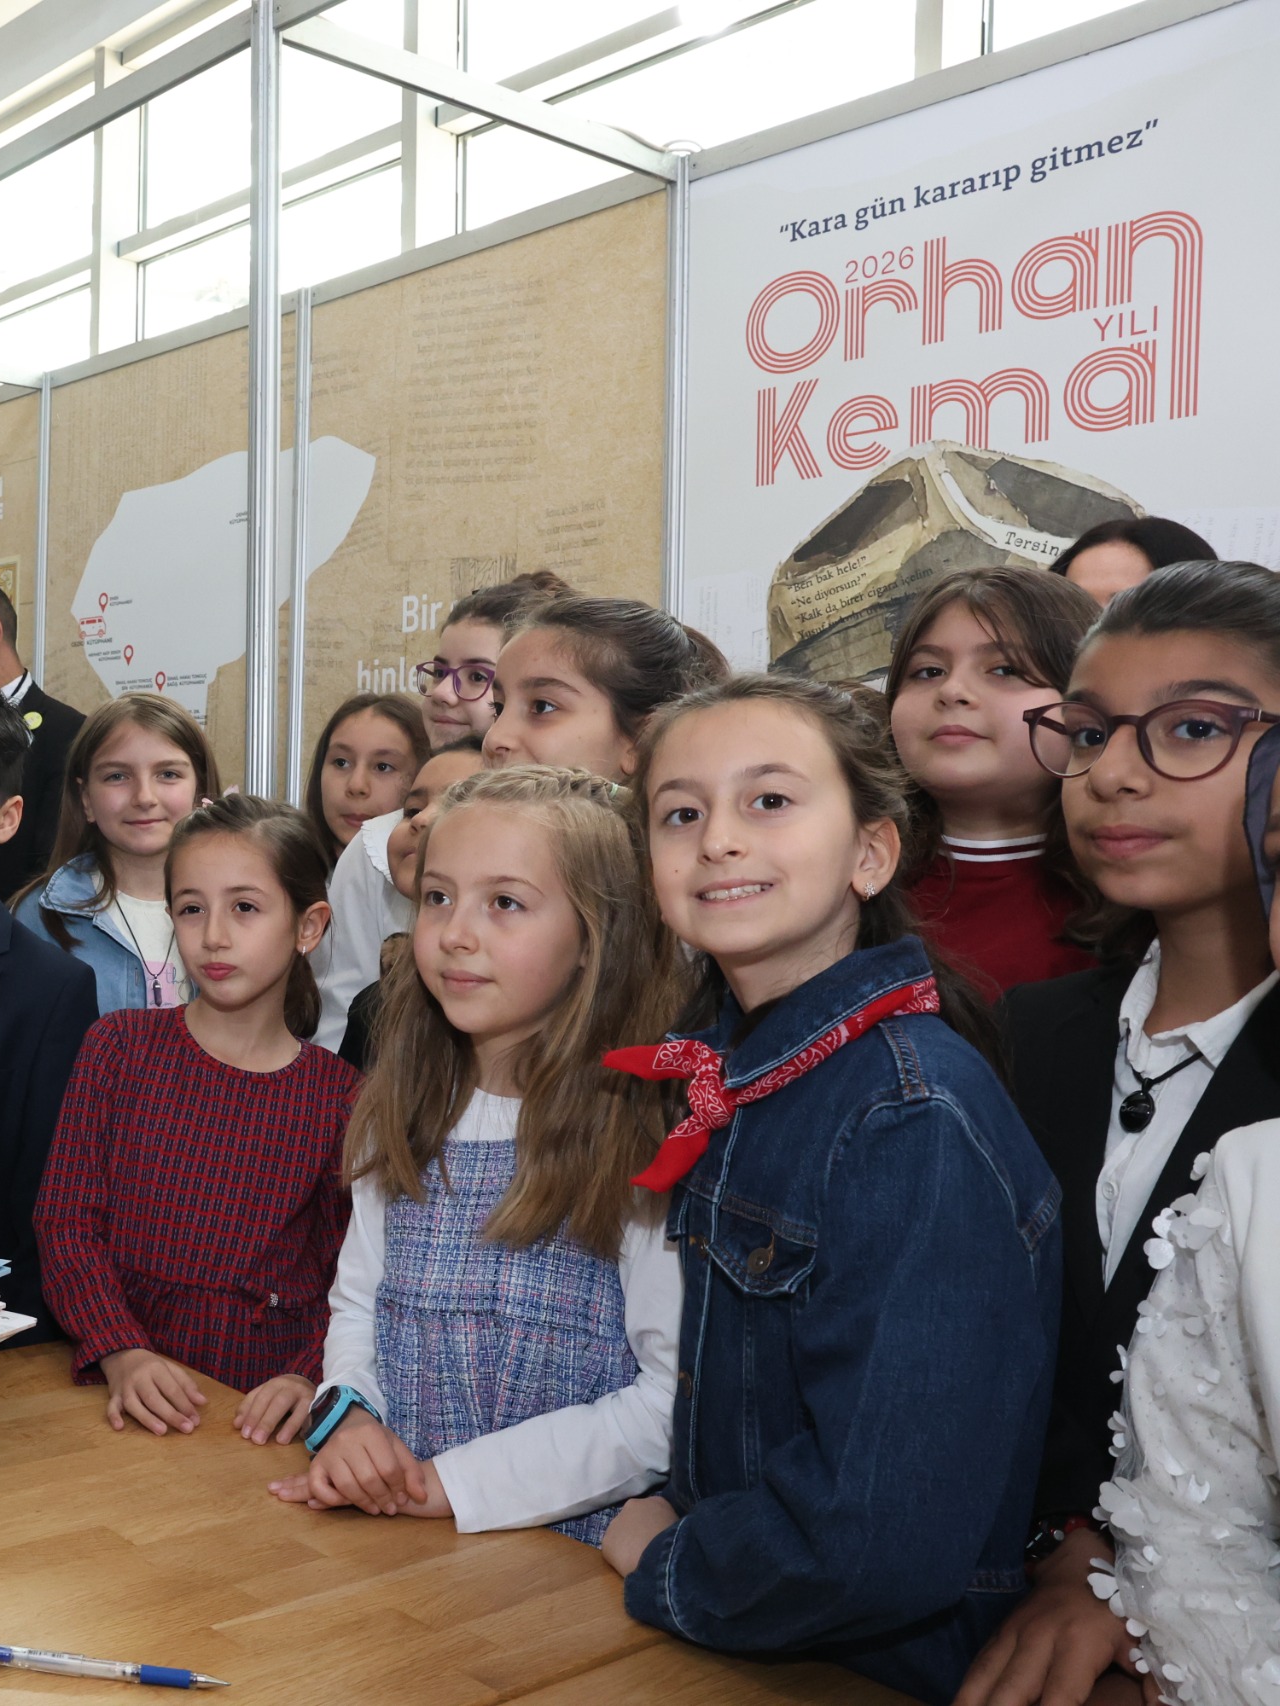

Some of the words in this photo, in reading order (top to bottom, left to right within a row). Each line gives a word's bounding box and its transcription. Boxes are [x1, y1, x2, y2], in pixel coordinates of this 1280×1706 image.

[779, 213, 848, 243] “Kara
[854, 196, 907, 231] gün
[913, 164, 1022, 209] kararıp
[1029, 118, 1160, 185] gitmez”
[844, 245, 915, 284] 2026
[745, 210, 1205, 378] Orhan
[1092, 305, 1160, 343] YILI
[1004, 531, 1066, 559] Tersin
[816, 570, 835, 584] bak
[840, 592, 865, 608] birer
[867, 580, 899, 600] cigara
[900, 567, 934, 587] içelim
[401, 593, 444, 634] Bir
